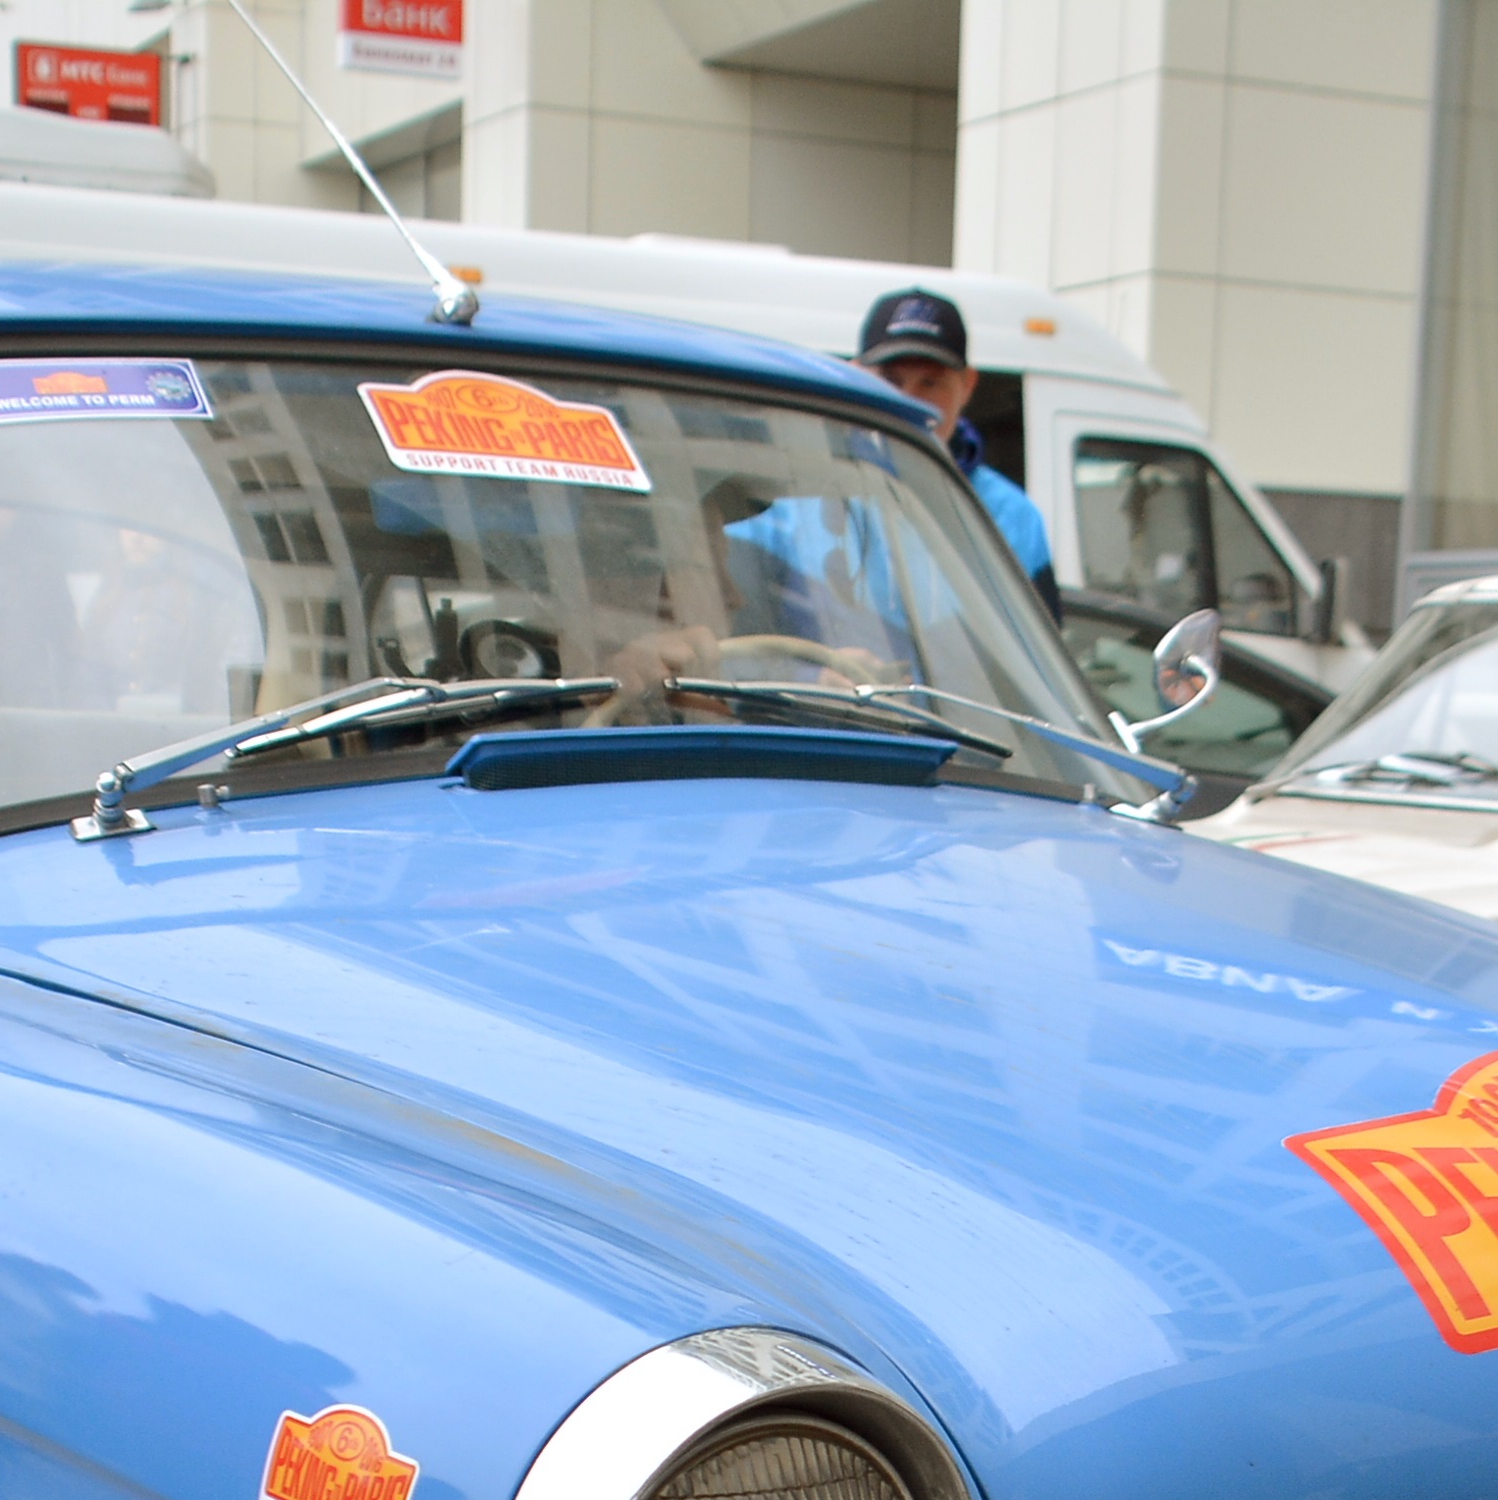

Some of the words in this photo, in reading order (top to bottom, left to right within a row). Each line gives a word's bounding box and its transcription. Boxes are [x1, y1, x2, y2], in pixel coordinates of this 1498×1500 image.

[82, 393, 105, 407] TO
[109, 393, 156, 407] PERM
[377, 395, 516, 452] PEKING
[519, 415, 626, 466] PARIS
[406, 453, 499, 473] SUPPORT
[506, 459, 560, 478] TEAM
[566, 465, 635, 488] RUSSIA
